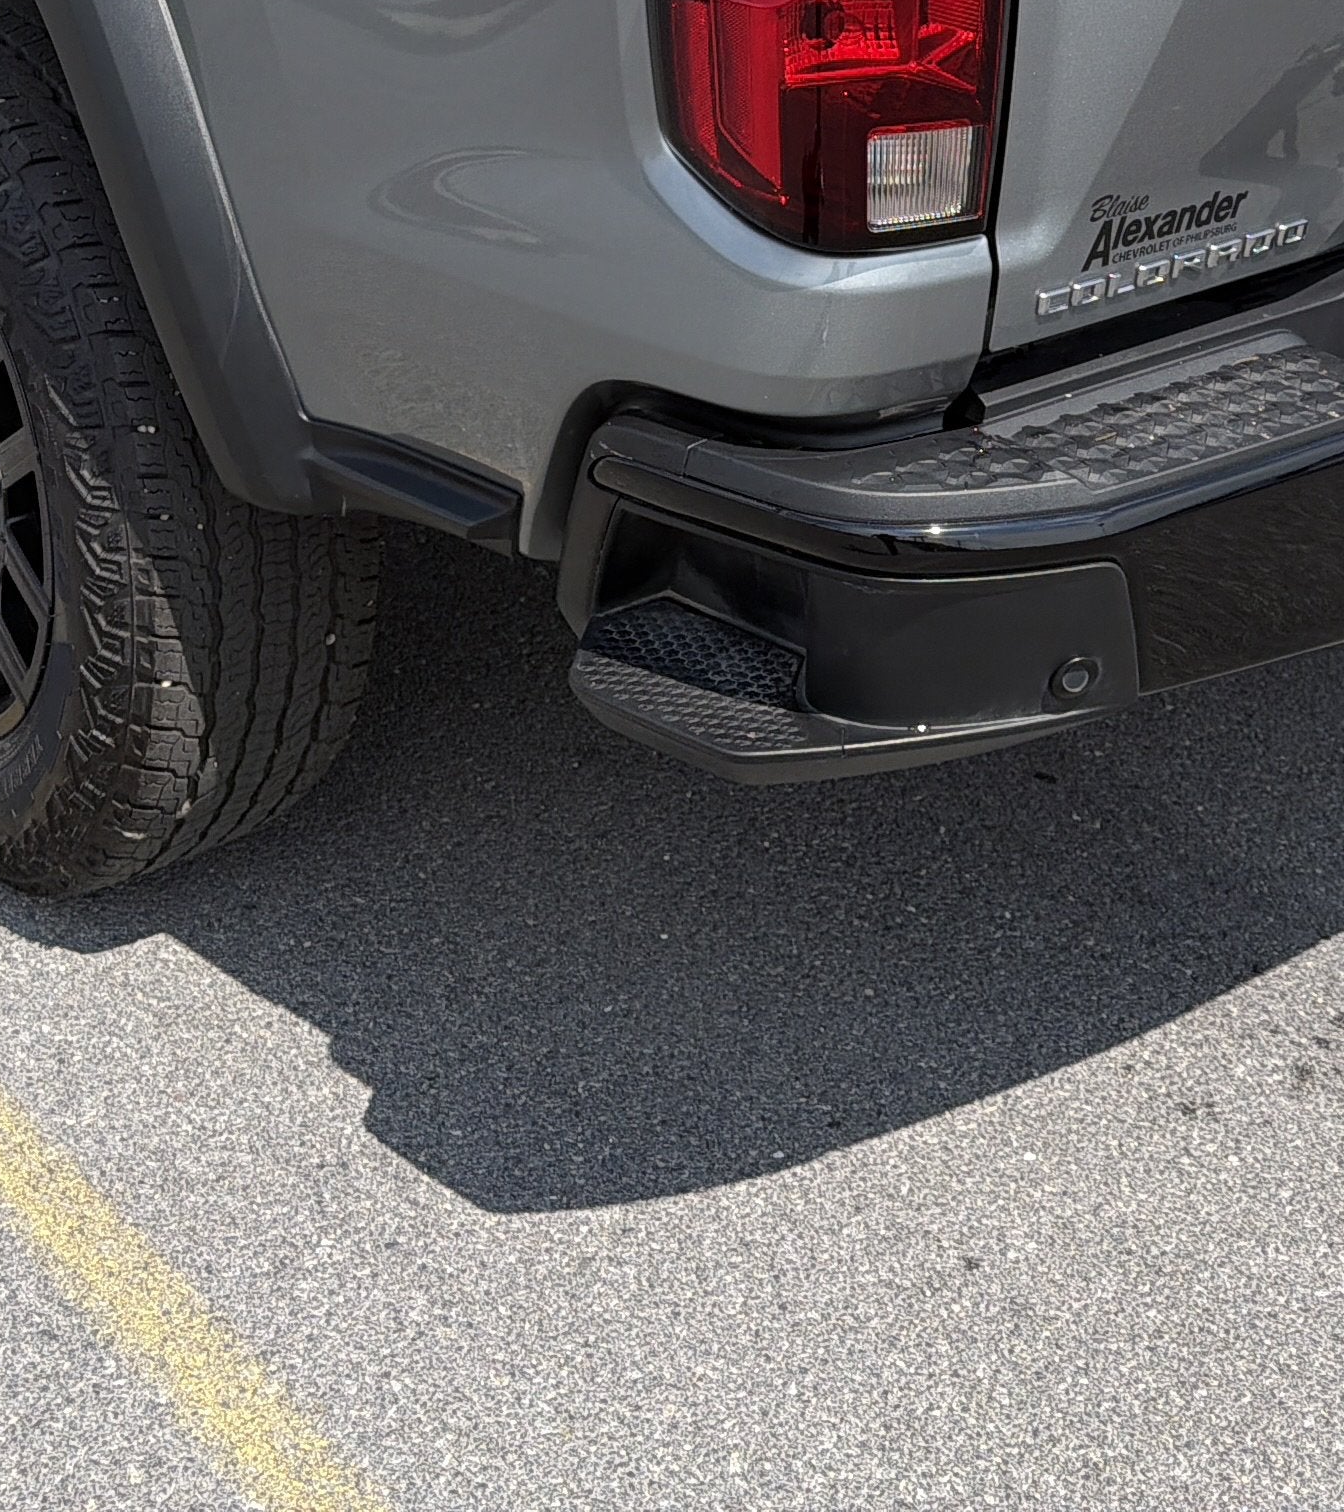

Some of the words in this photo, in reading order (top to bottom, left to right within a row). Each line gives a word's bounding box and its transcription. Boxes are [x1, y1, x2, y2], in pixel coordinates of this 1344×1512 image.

[1081, 190, 1251, 272] Alexander
[1089, 194, 1150, 223] Blaise
[1035, 218, 1309, 317] COLORADO
[1112, 240, 1171, 264] CHEVROLET
[1172, 236, 1185, 248] OF
[1185, 222, 1238, 245] PHILIPSBURG
